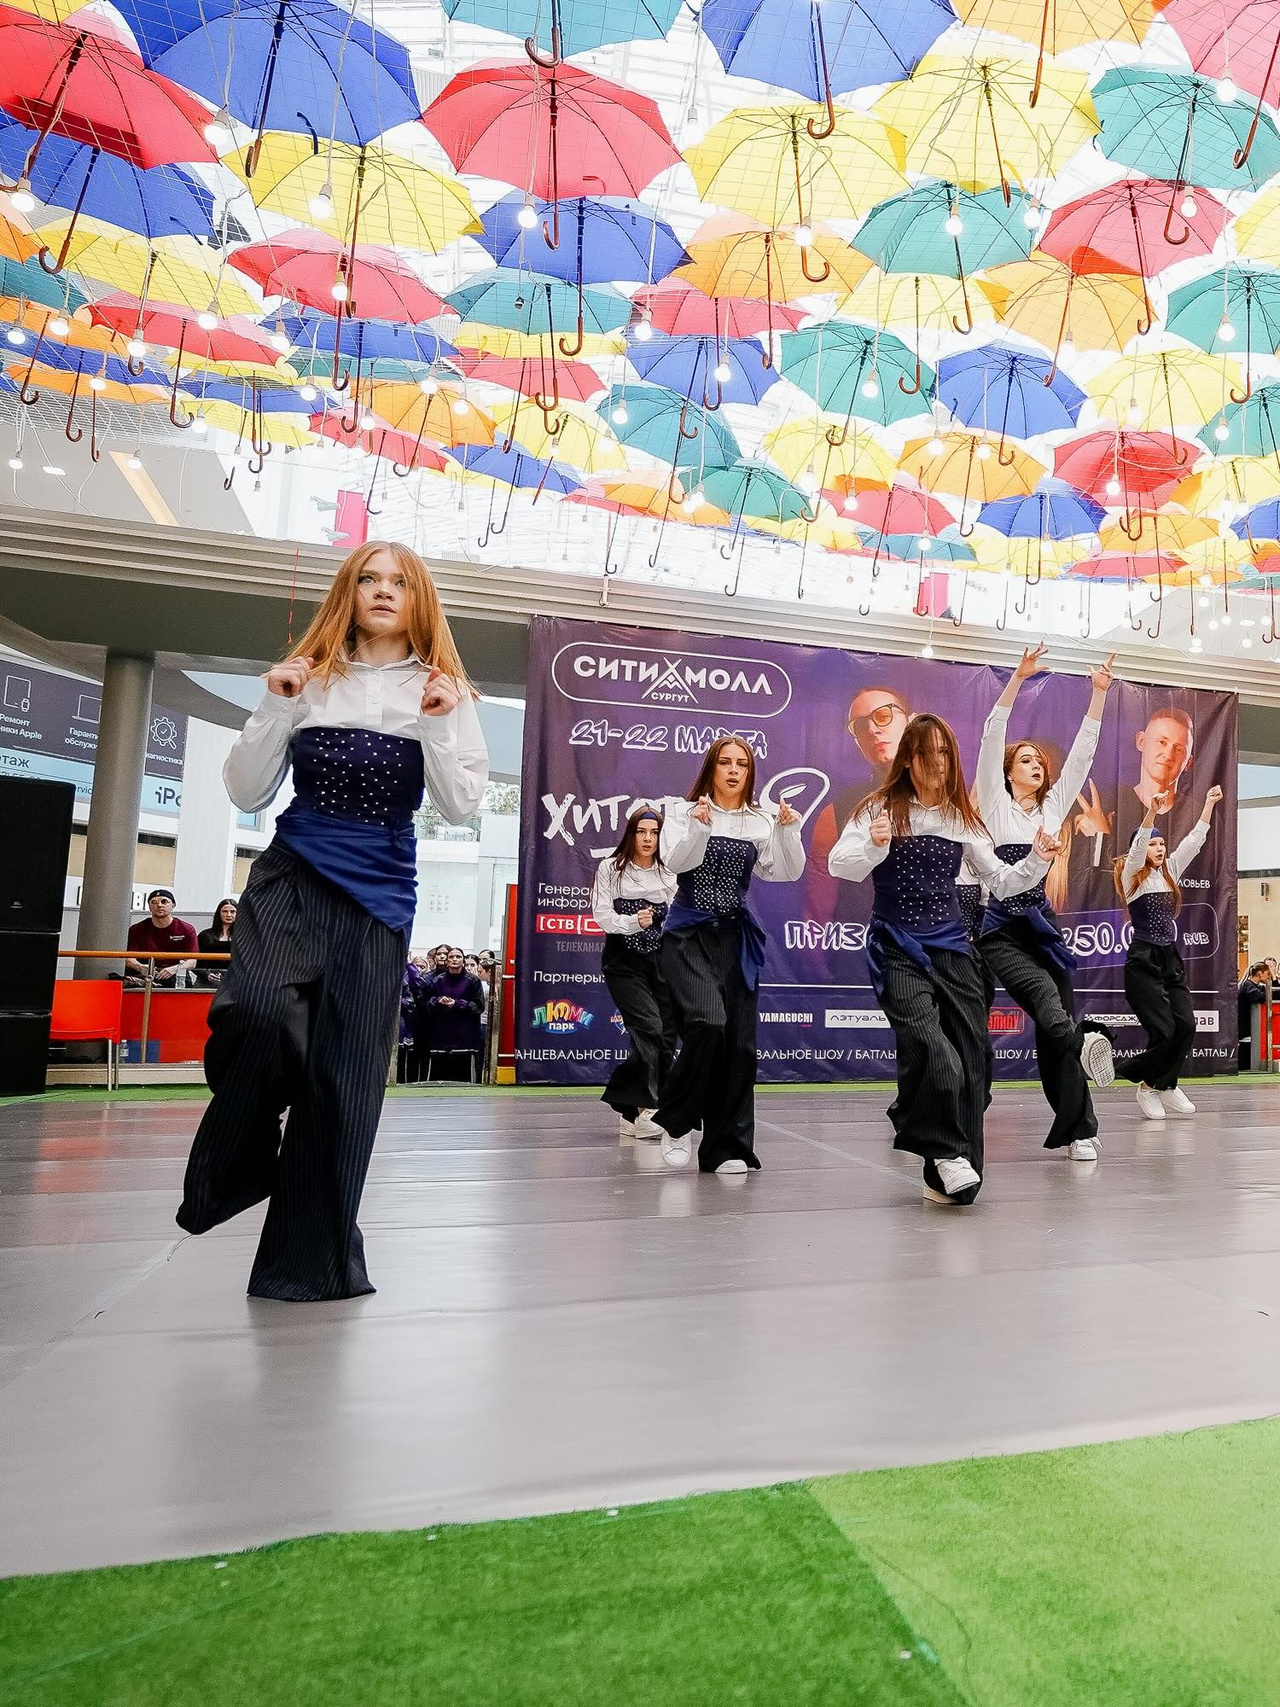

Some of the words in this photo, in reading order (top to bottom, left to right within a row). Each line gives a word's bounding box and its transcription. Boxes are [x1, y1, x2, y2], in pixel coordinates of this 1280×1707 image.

[573, 655, 659, 683] СИТИ
[685, 666, 773, 695] МОЛЛ
[651, 691, 690, 703] СУРГУТ
[0, 713, 31, 727] Ремонт
[19, 729, 43, 740] Apple
[569, 719, 669, 752] 21-22
[0, 755, 30, 768] таж
[1183, 932, 1210, 946] RUB
[533, 970, 606, 985] Партнеры:
[759, 1012, 813, 1023] YAMAGUCHI
[1094, 1015, 1136, 1023] ФОРСАЖ
[548, 1022, 575, 1032] парк
[515, 1049, 612, 1061] АНЦЕВАЛЬНОЕ
[814, 1050, 845, 1060] ШОУ
[995, 1050, 1023, 1059] ШОУ
